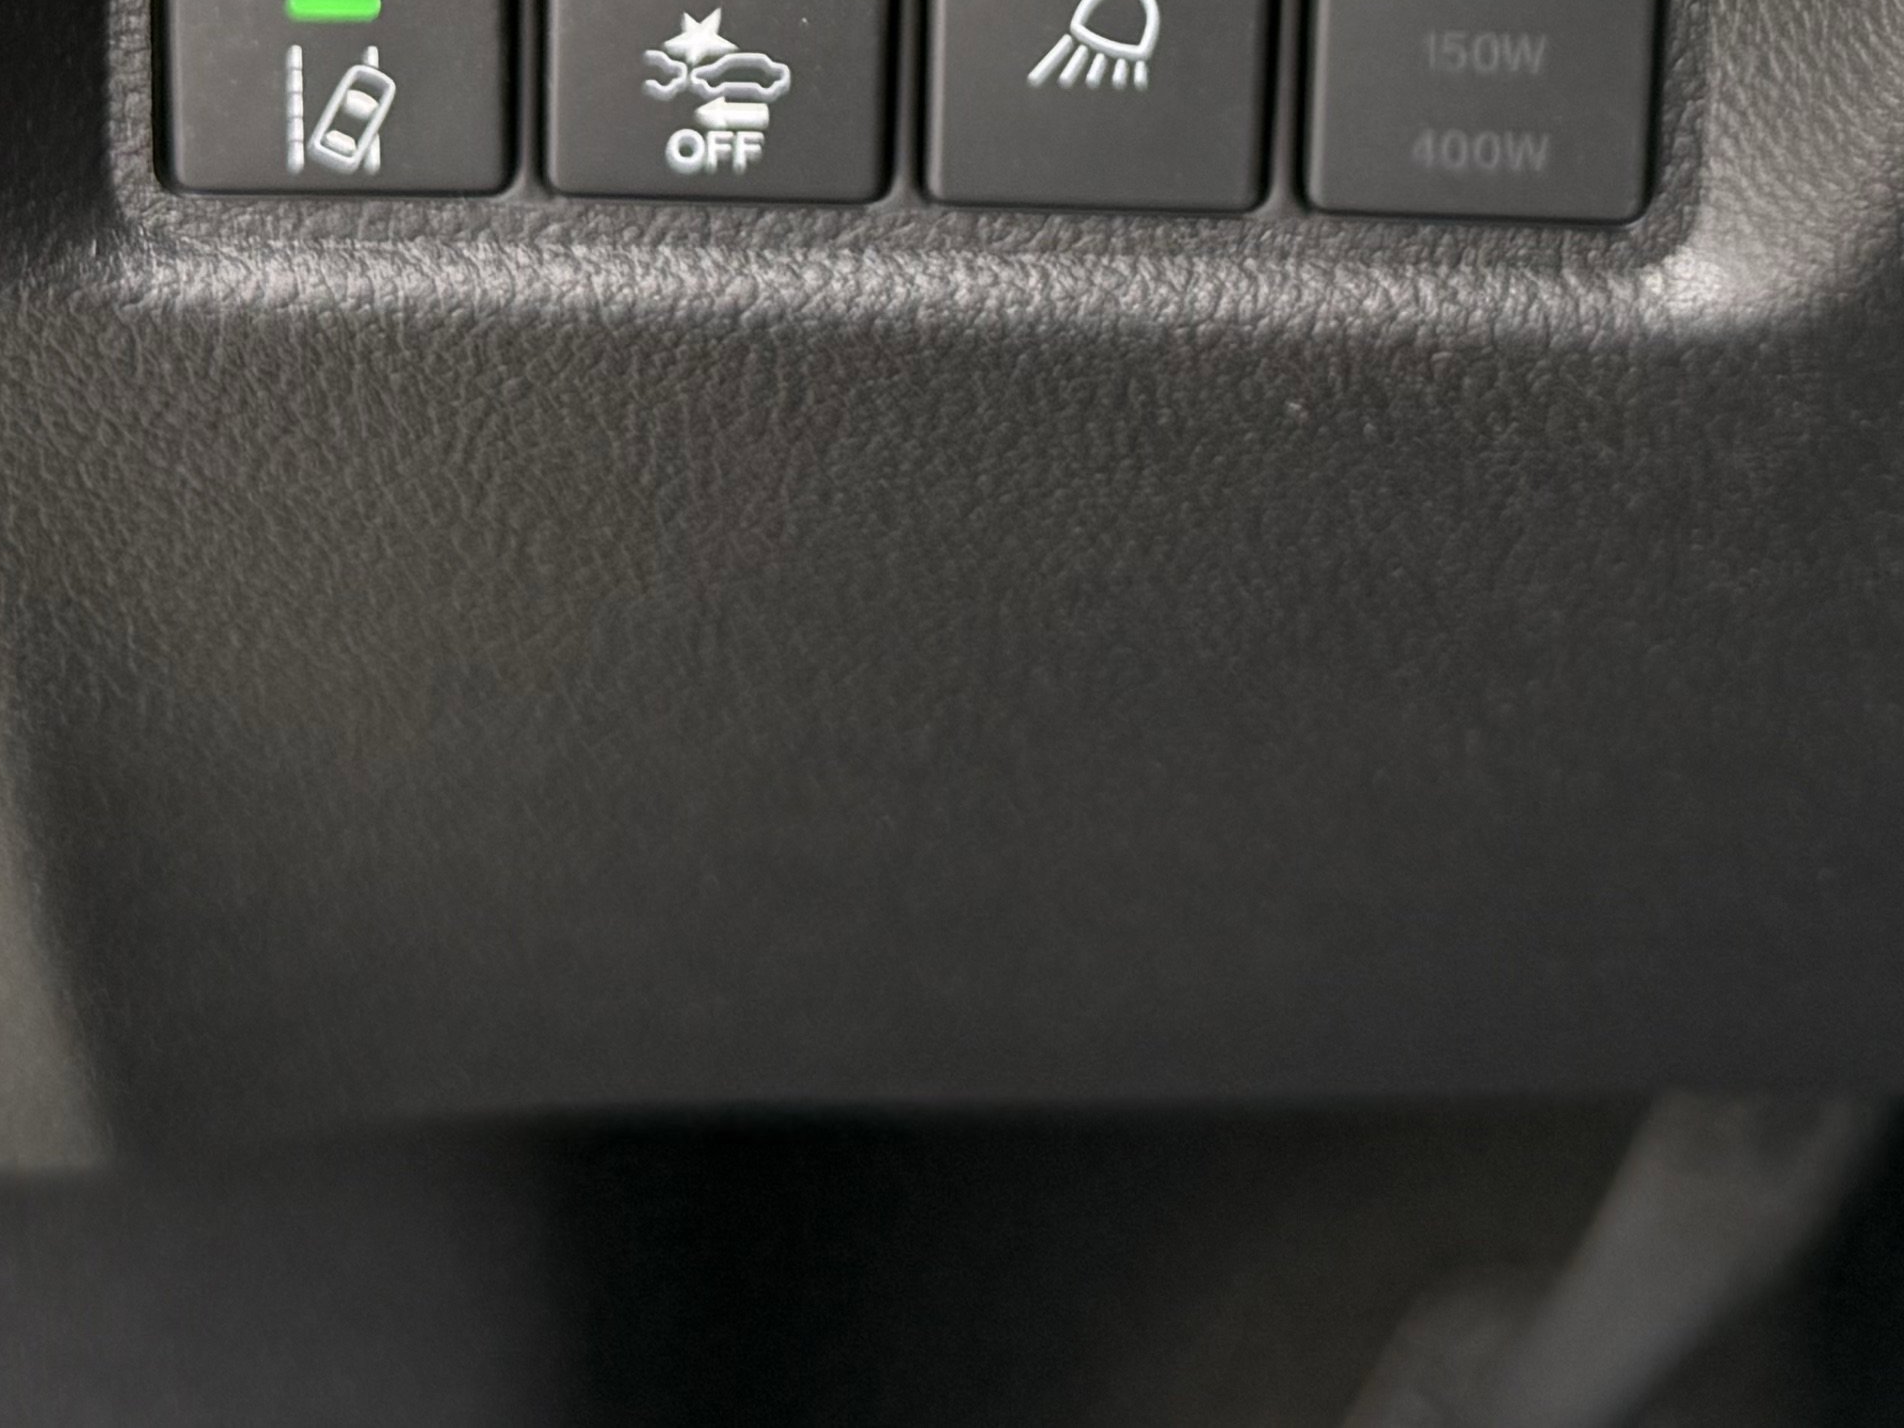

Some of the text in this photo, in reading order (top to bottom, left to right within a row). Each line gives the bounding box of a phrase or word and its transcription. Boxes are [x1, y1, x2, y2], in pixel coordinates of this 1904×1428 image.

[1423, 30, 1547, 74] 150W
[666, 129, 764, 175] OFF
[1411, 128, 1550, 172] 400W
